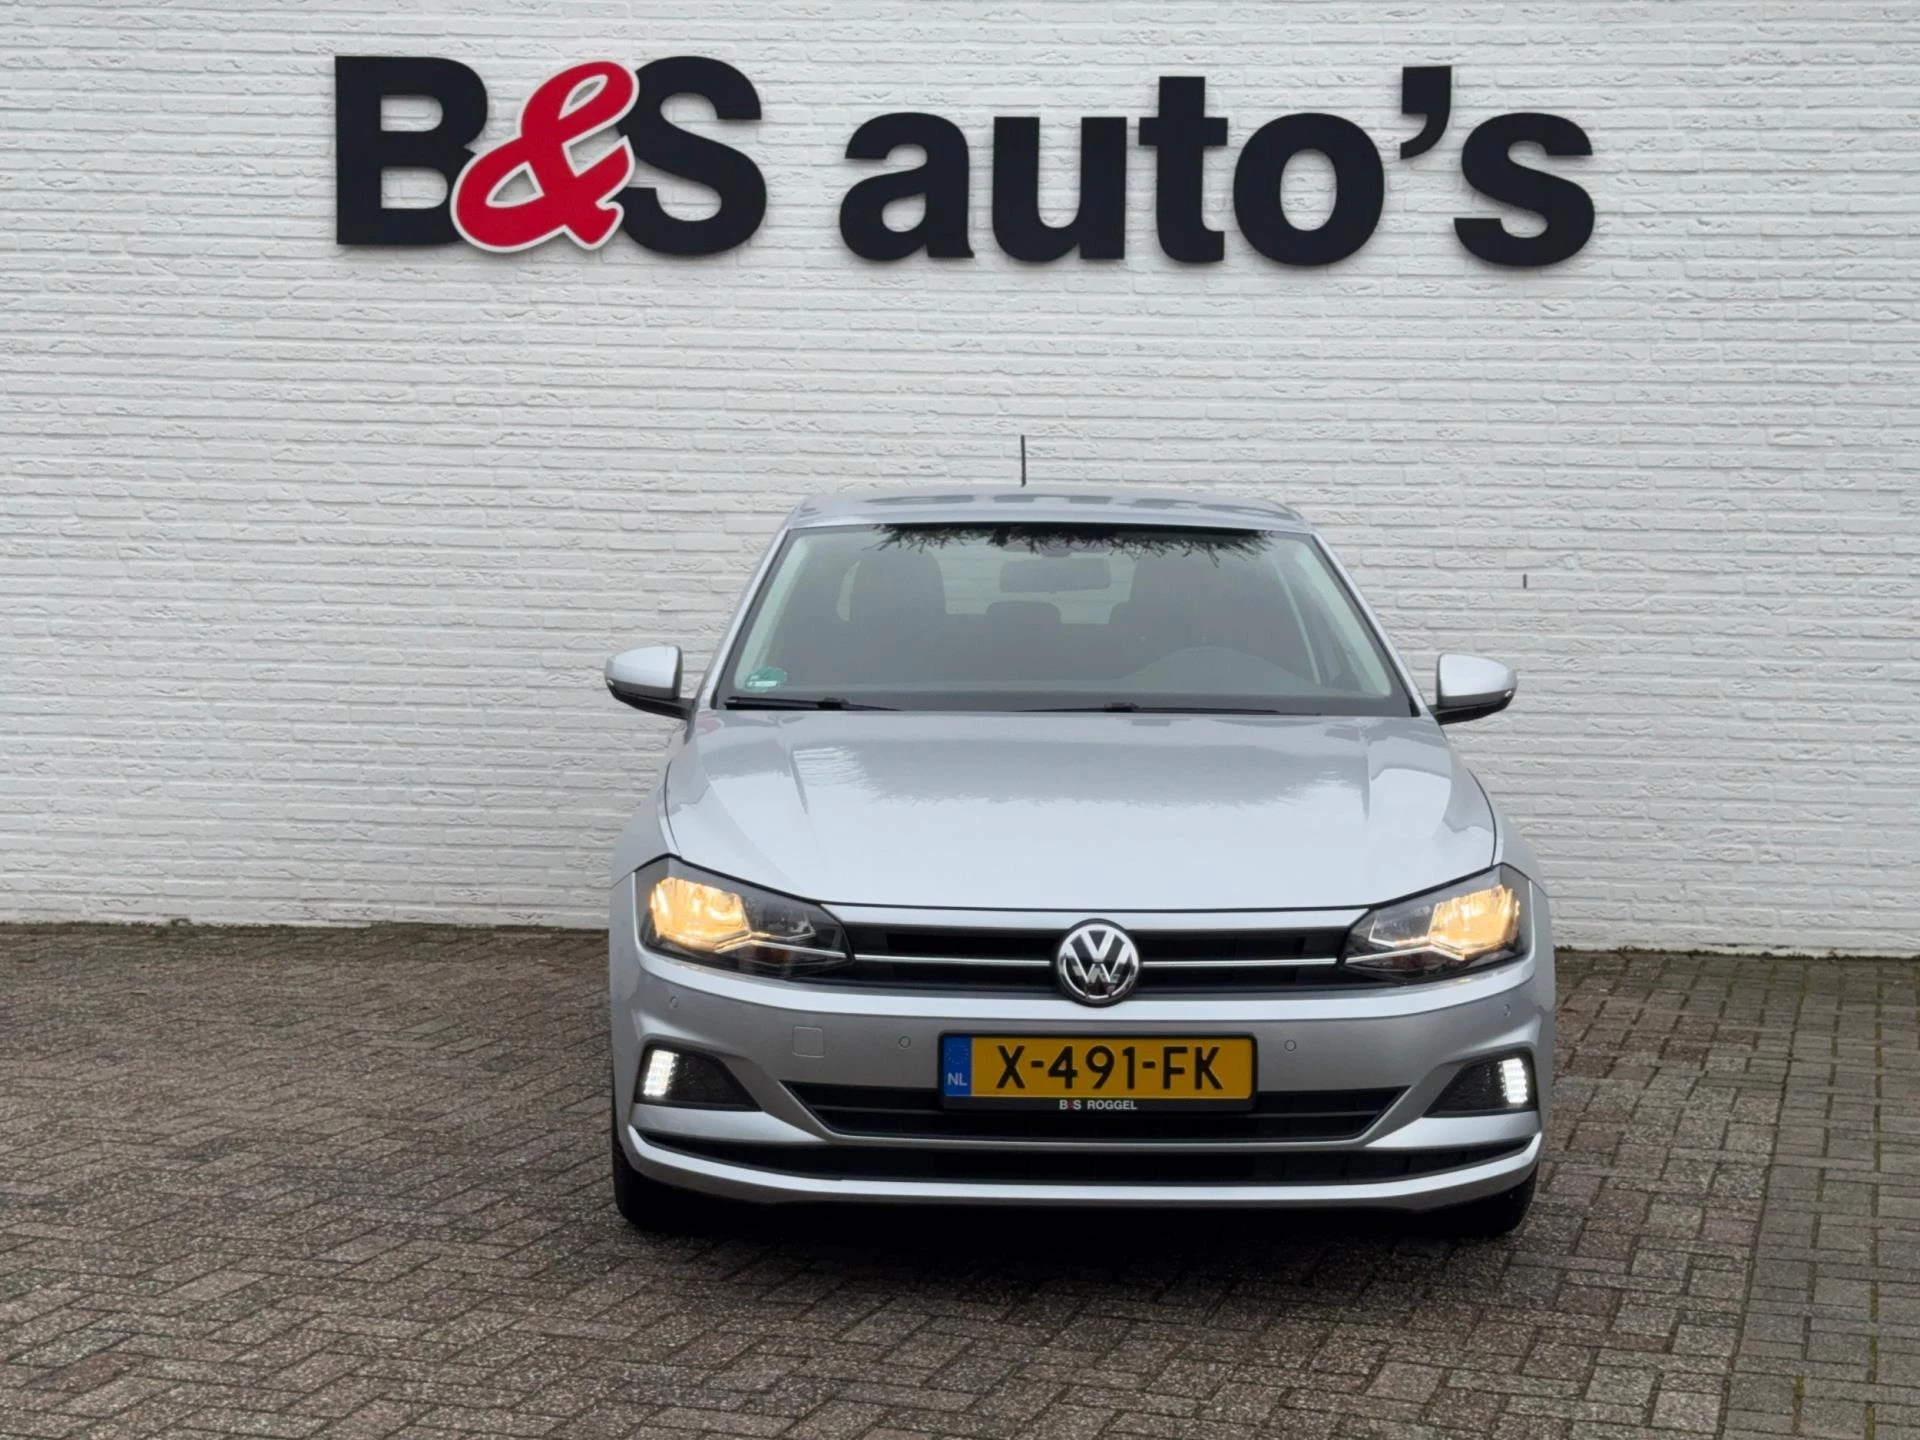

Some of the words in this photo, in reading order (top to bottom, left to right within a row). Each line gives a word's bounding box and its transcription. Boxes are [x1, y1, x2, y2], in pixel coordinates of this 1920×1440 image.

[335, 55, 767, 257] B&S
[839, 65, 1596, 267] auto's
[1058, 924, 1138, 999] VW
[948, 1072, 967, 1087] NL
[996, 1045, 1223, 1090] X-491-FK
[1087, 1100, 1138, 1111] ROGGEL
